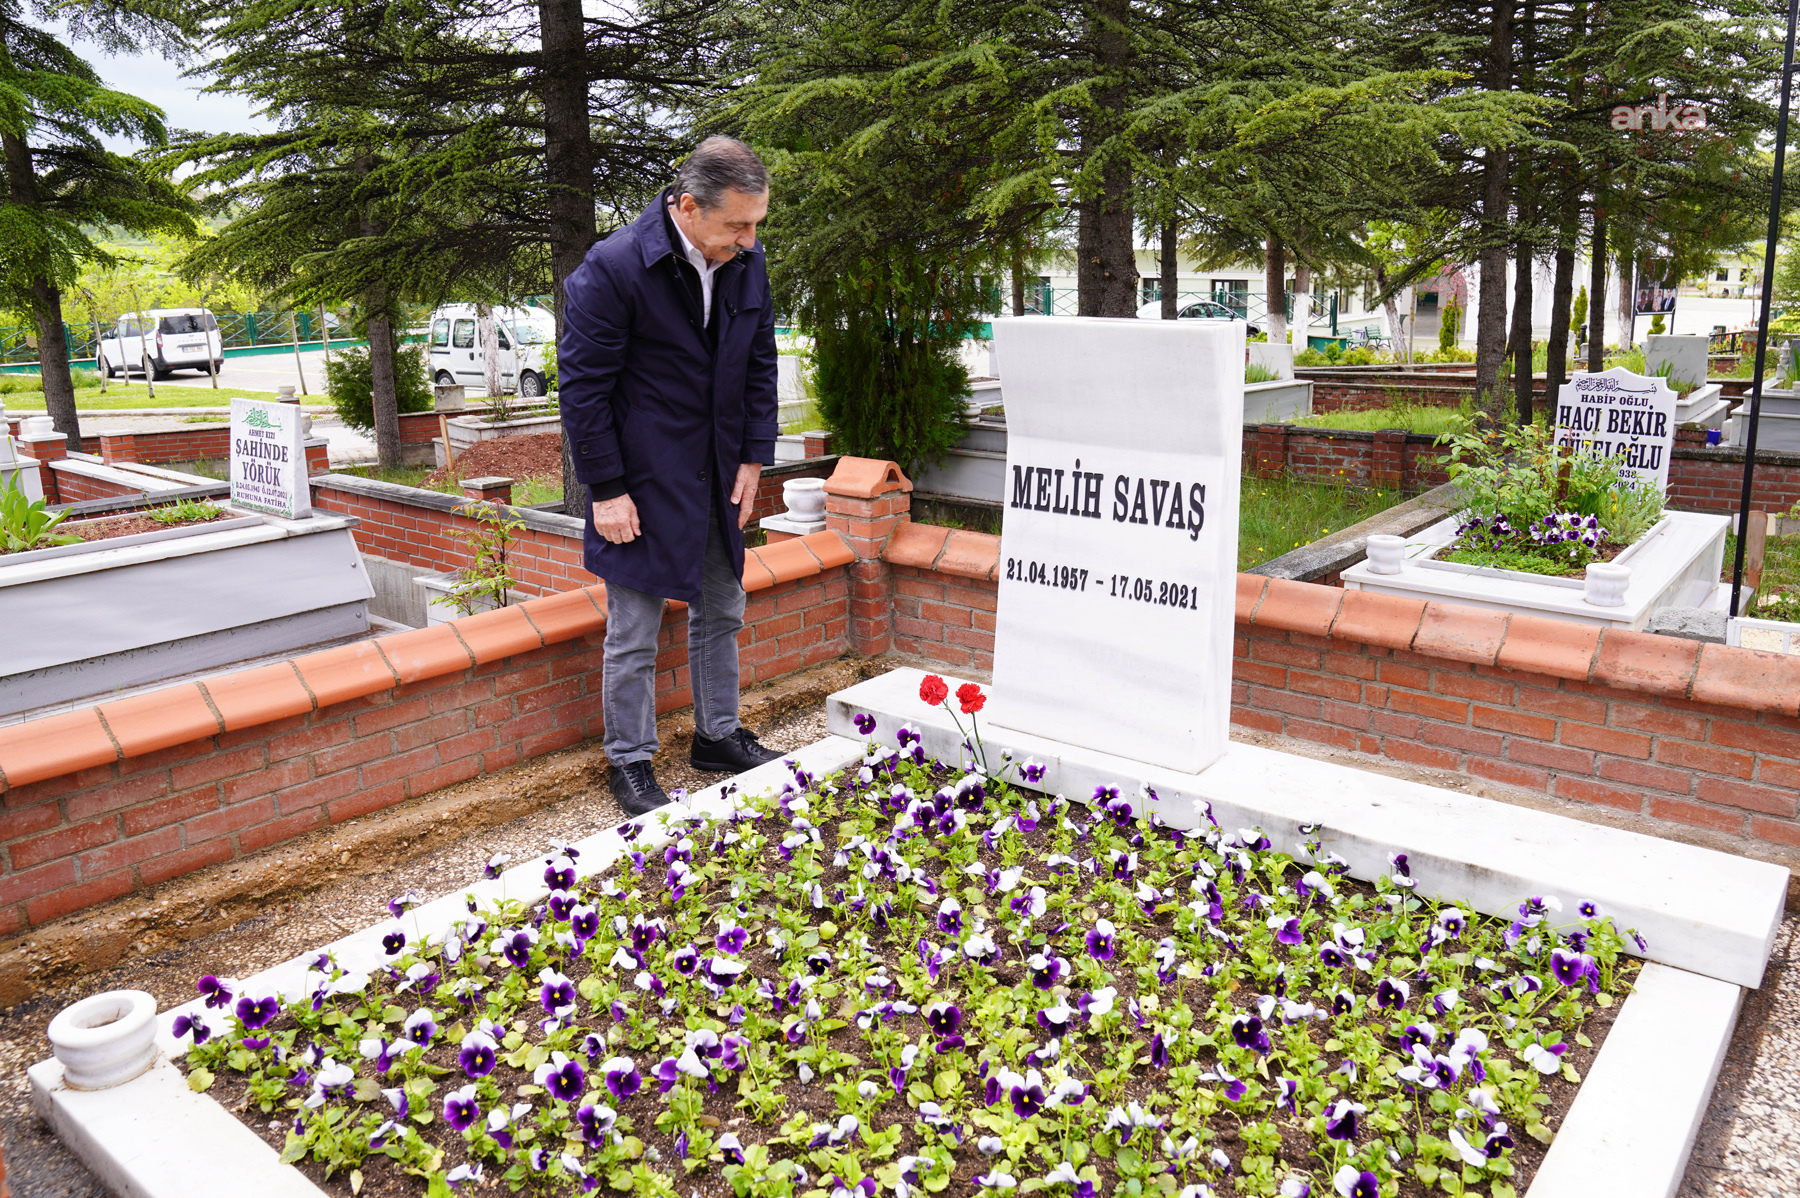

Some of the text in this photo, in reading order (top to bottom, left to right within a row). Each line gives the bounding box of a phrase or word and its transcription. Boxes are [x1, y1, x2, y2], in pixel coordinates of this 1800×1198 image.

[1581, 393, 1649, 406] HABİP OĞLU
[248, 429, 265, 438] AHMET
[1559, 405, 1667, 437] HACI BEKİR
[235, 438, 289, 463] ŞAHİNDE
[242, 458, 281, 487] YÖRÜK
[1616, 469, 1637, 479] 938
[236, 491, 263, 503] RUHUNA
[1010, 458, 1206, 542] MELİH SAVAŞ
[1006, 557, 1088, 592] 21.04.1957
[1110, 574, 1198, 610] 17.05.2021
